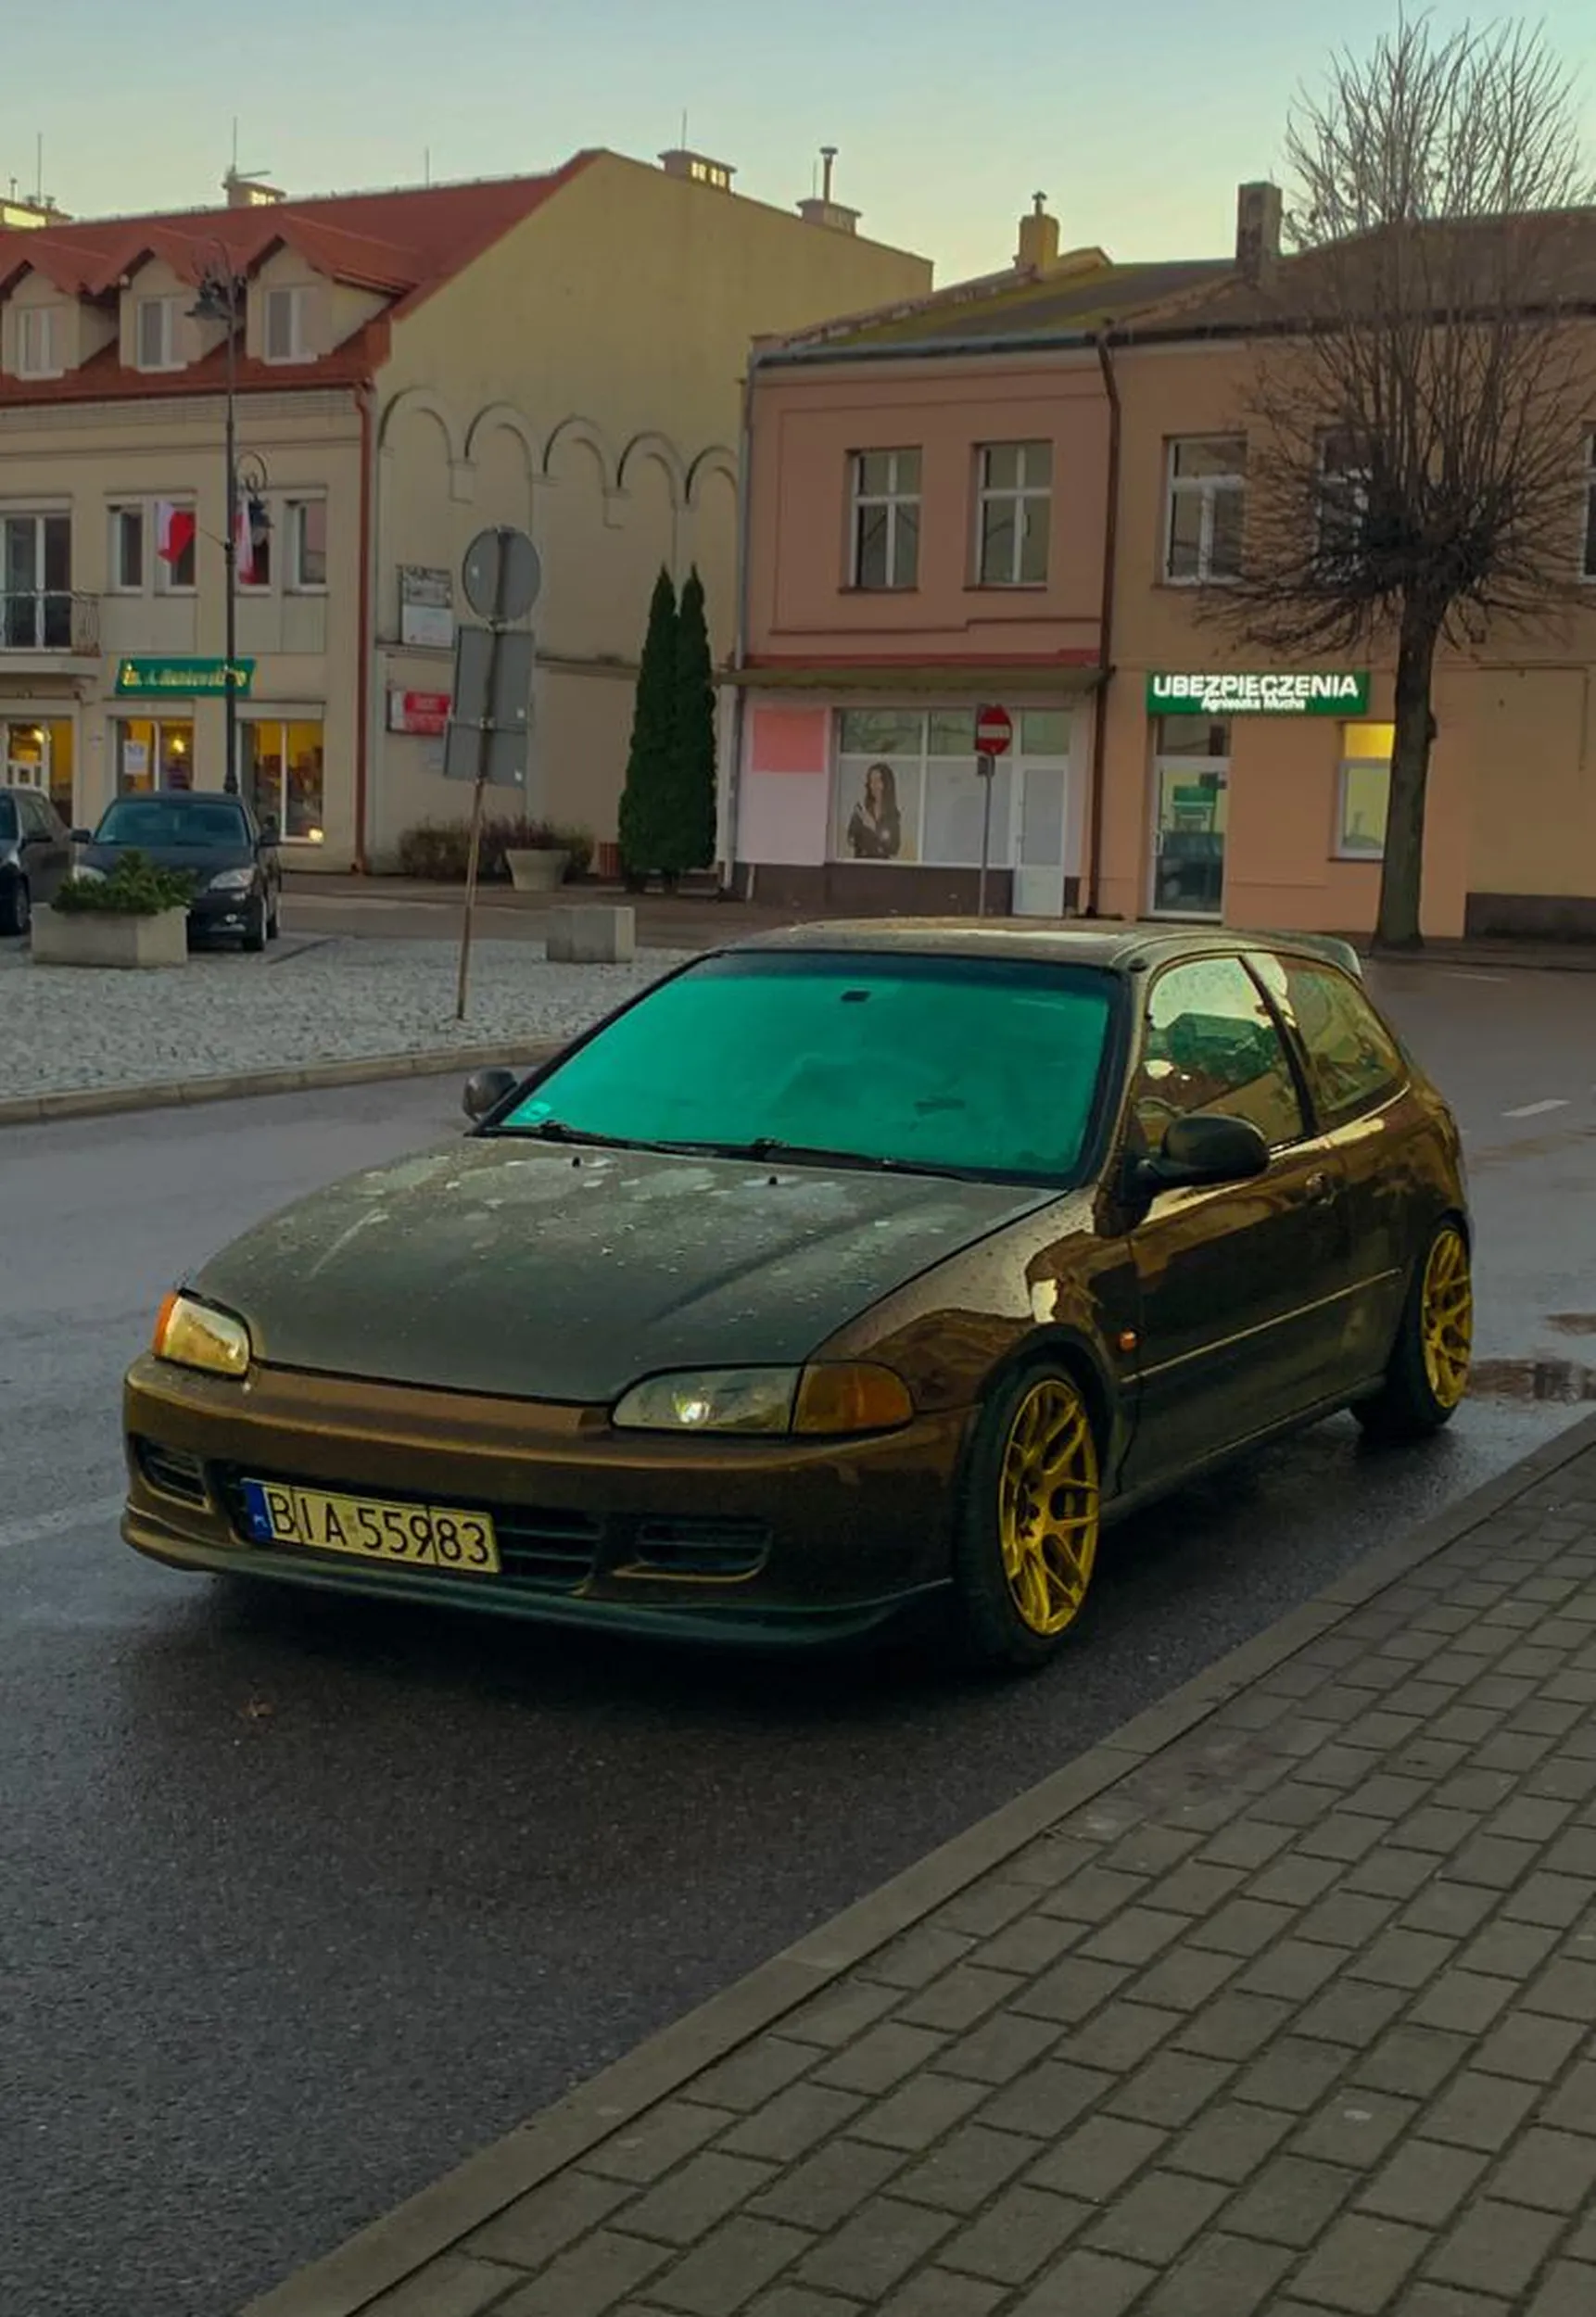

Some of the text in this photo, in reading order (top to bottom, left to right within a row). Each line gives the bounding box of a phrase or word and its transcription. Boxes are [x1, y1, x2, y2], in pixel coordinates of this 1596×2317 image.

[1153, 675, 1359, 698] UBEZPIECZENIA
[268, 1492, 489, 1564] BIA 55983
